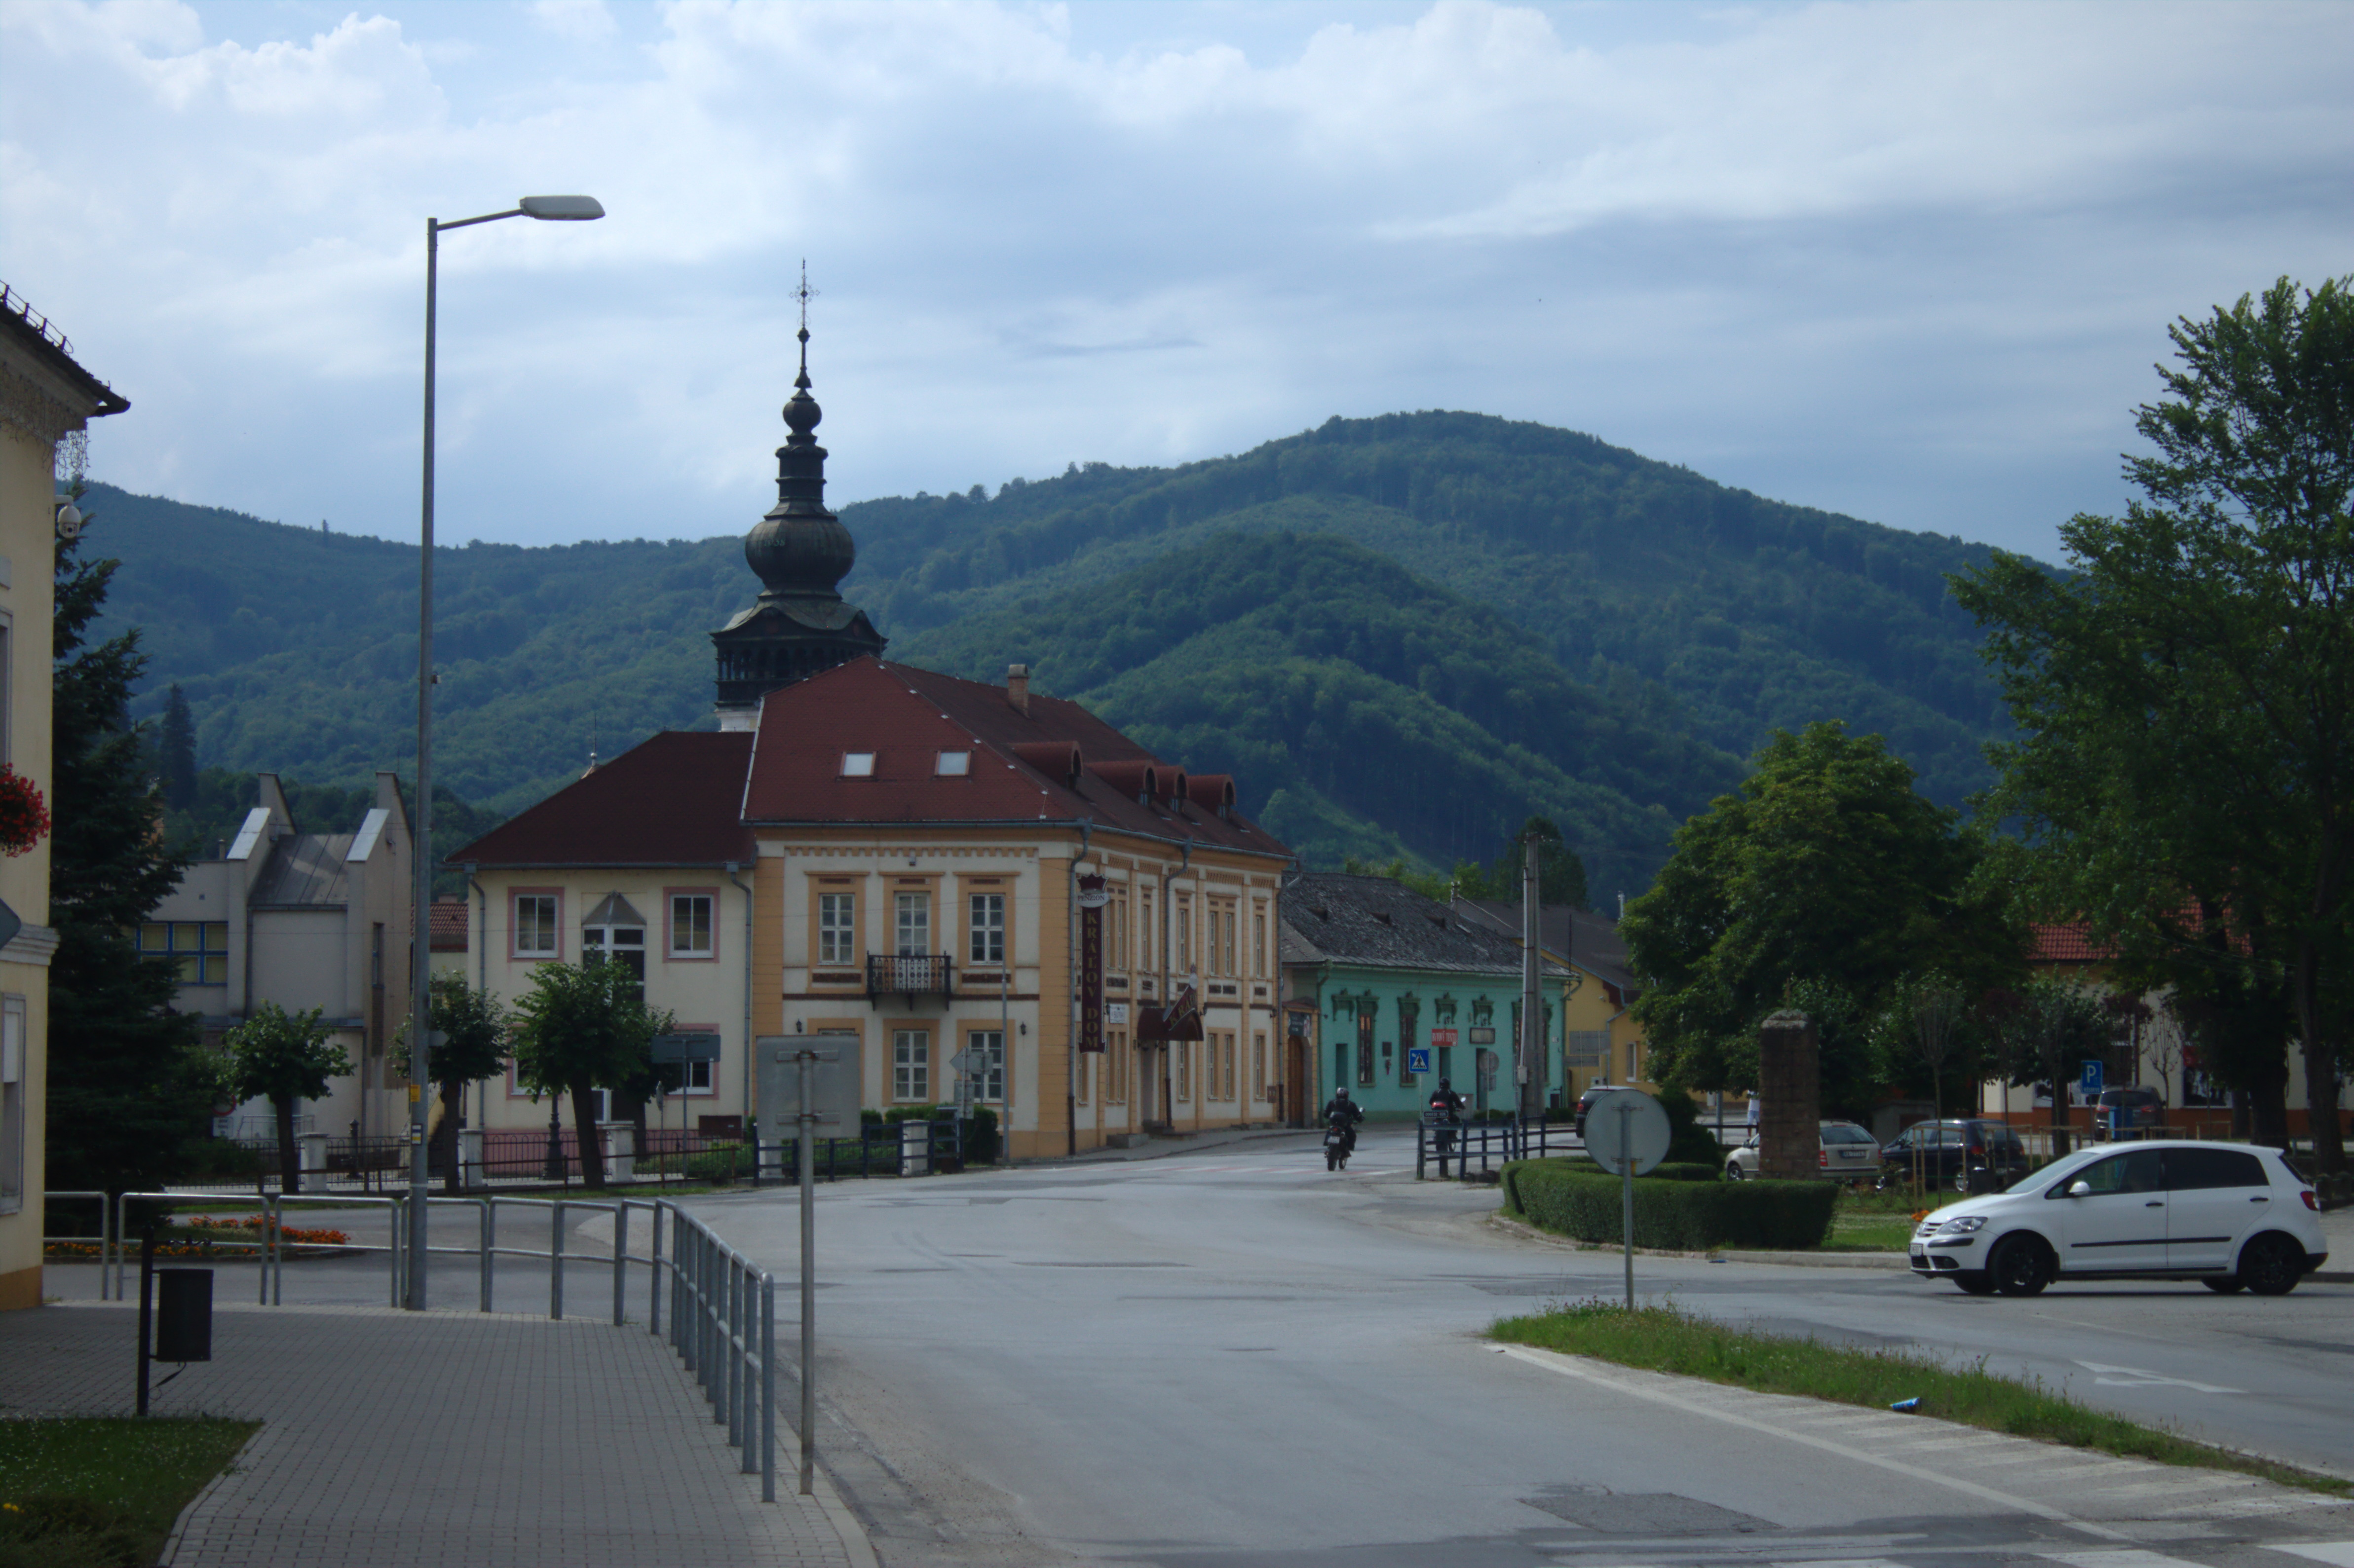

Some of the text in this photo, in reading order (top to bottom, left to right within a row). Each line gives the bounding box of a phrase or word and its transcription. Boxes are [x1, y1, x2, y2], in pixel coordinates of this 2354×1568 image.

[1086, 913, 1099, 1048] KRÁĽOV DOM
[2087, 1065, 2096, 1083] P
